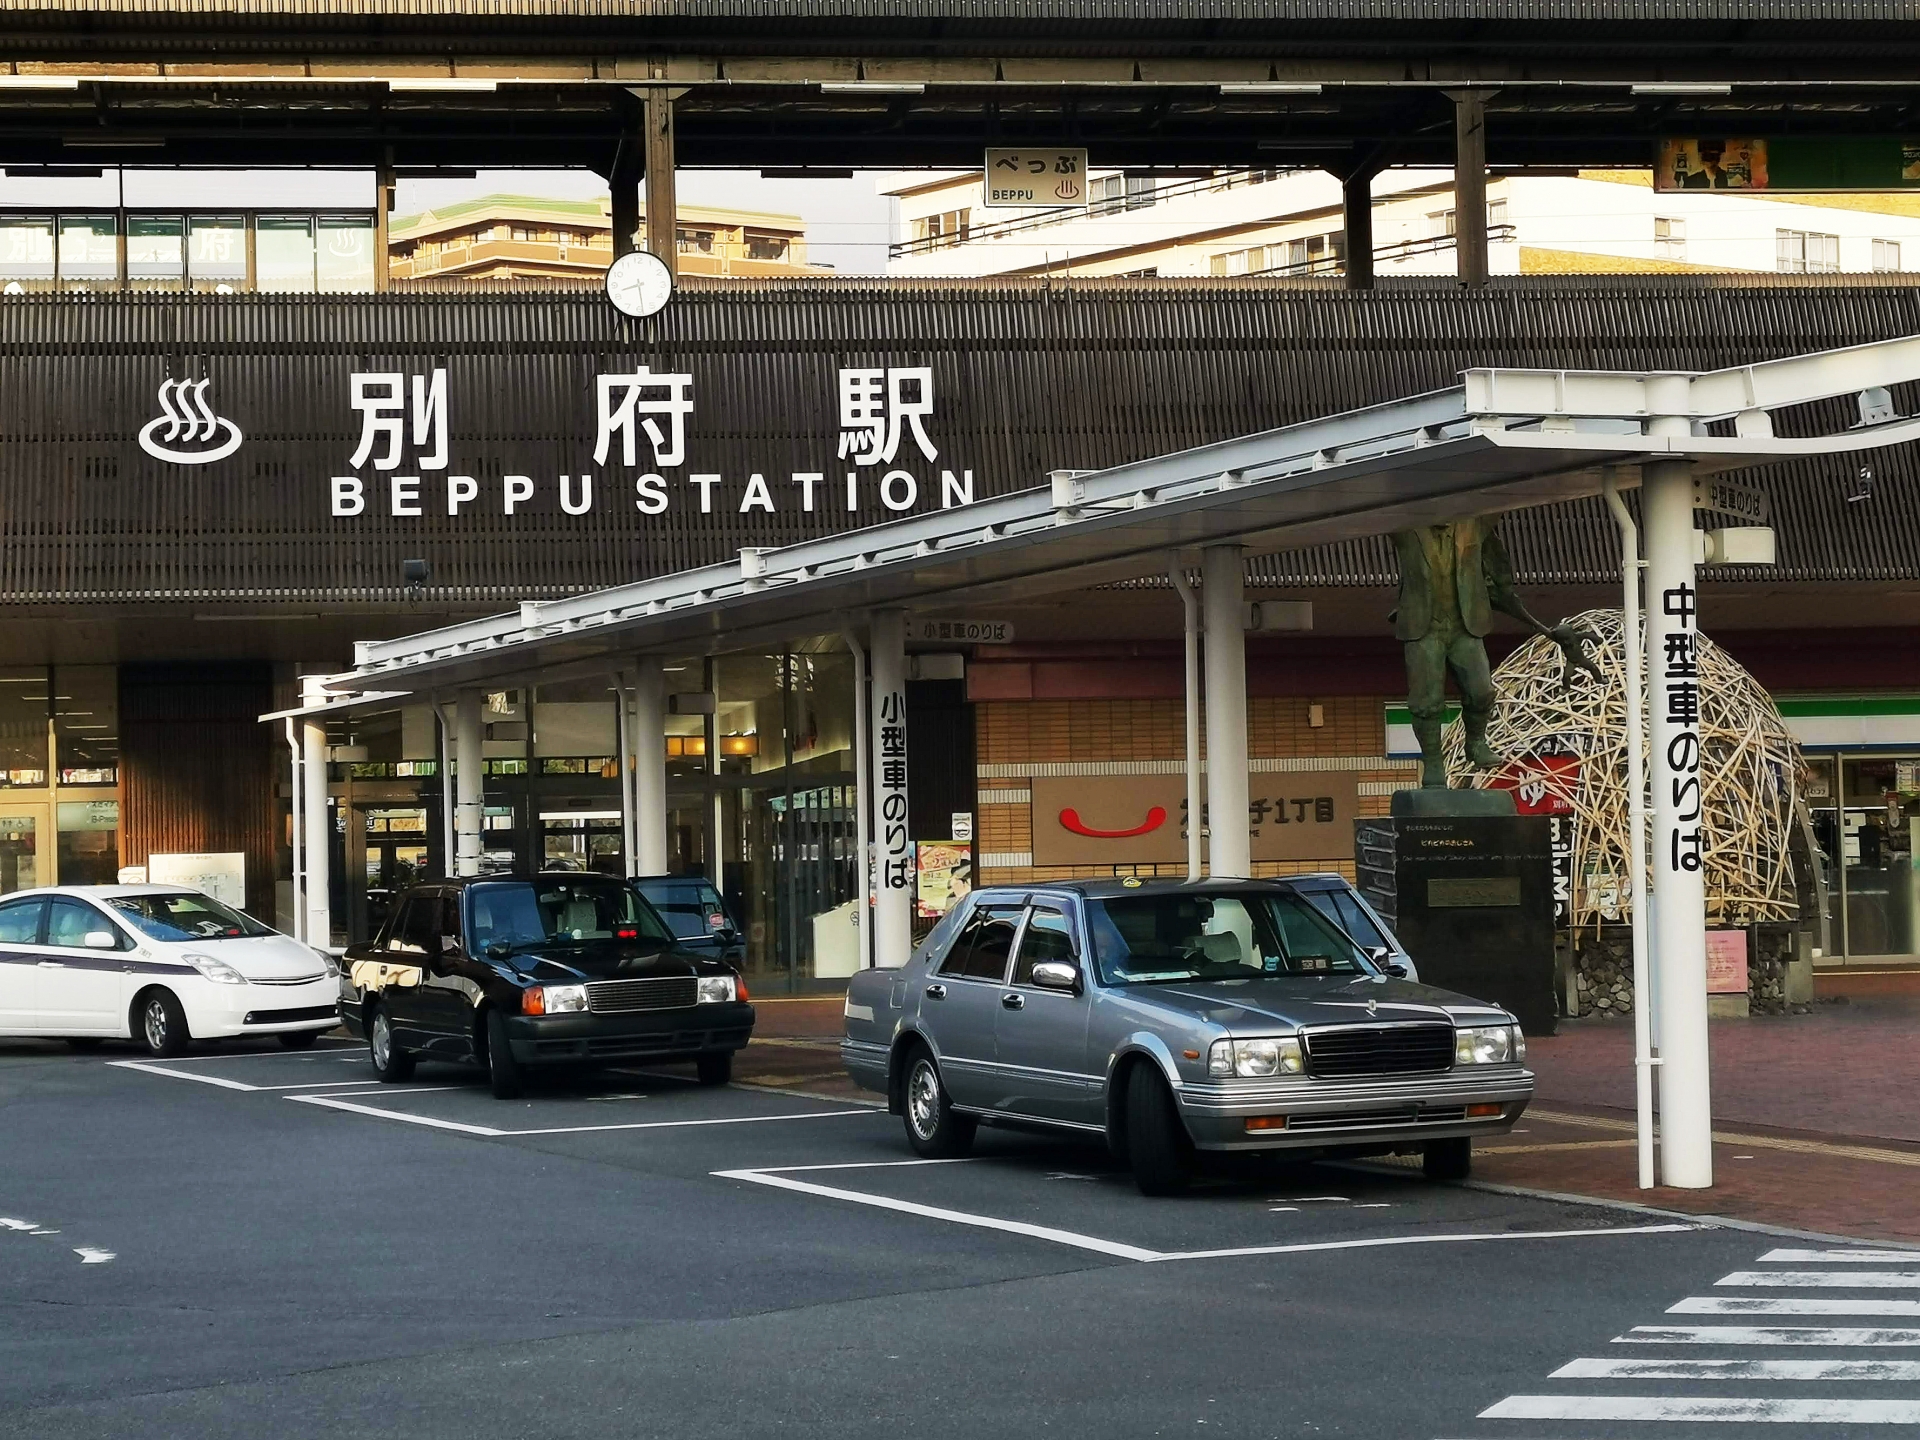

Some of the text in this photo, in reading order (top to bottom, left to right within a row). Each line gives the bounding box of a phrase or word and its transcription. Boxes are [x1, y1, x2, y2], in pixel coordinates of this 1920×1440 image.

[995, 156, 1077, 174] べっぷ
[992, 190, 1033, 200] BEPPU
[349, 365, 939, 471] 別府駅
[332, 468, 975, 517] BEPPU STATION
[1711, 483, 1761, 516] 中型車のりば
[924, 622, 1006, 640] 小型車のりば
[1664, 582, 1703, 872] 中型車のりば
[881, 691, 908, 889] 小型車のりば
[1518, 770, 1546, 807] ゆ
